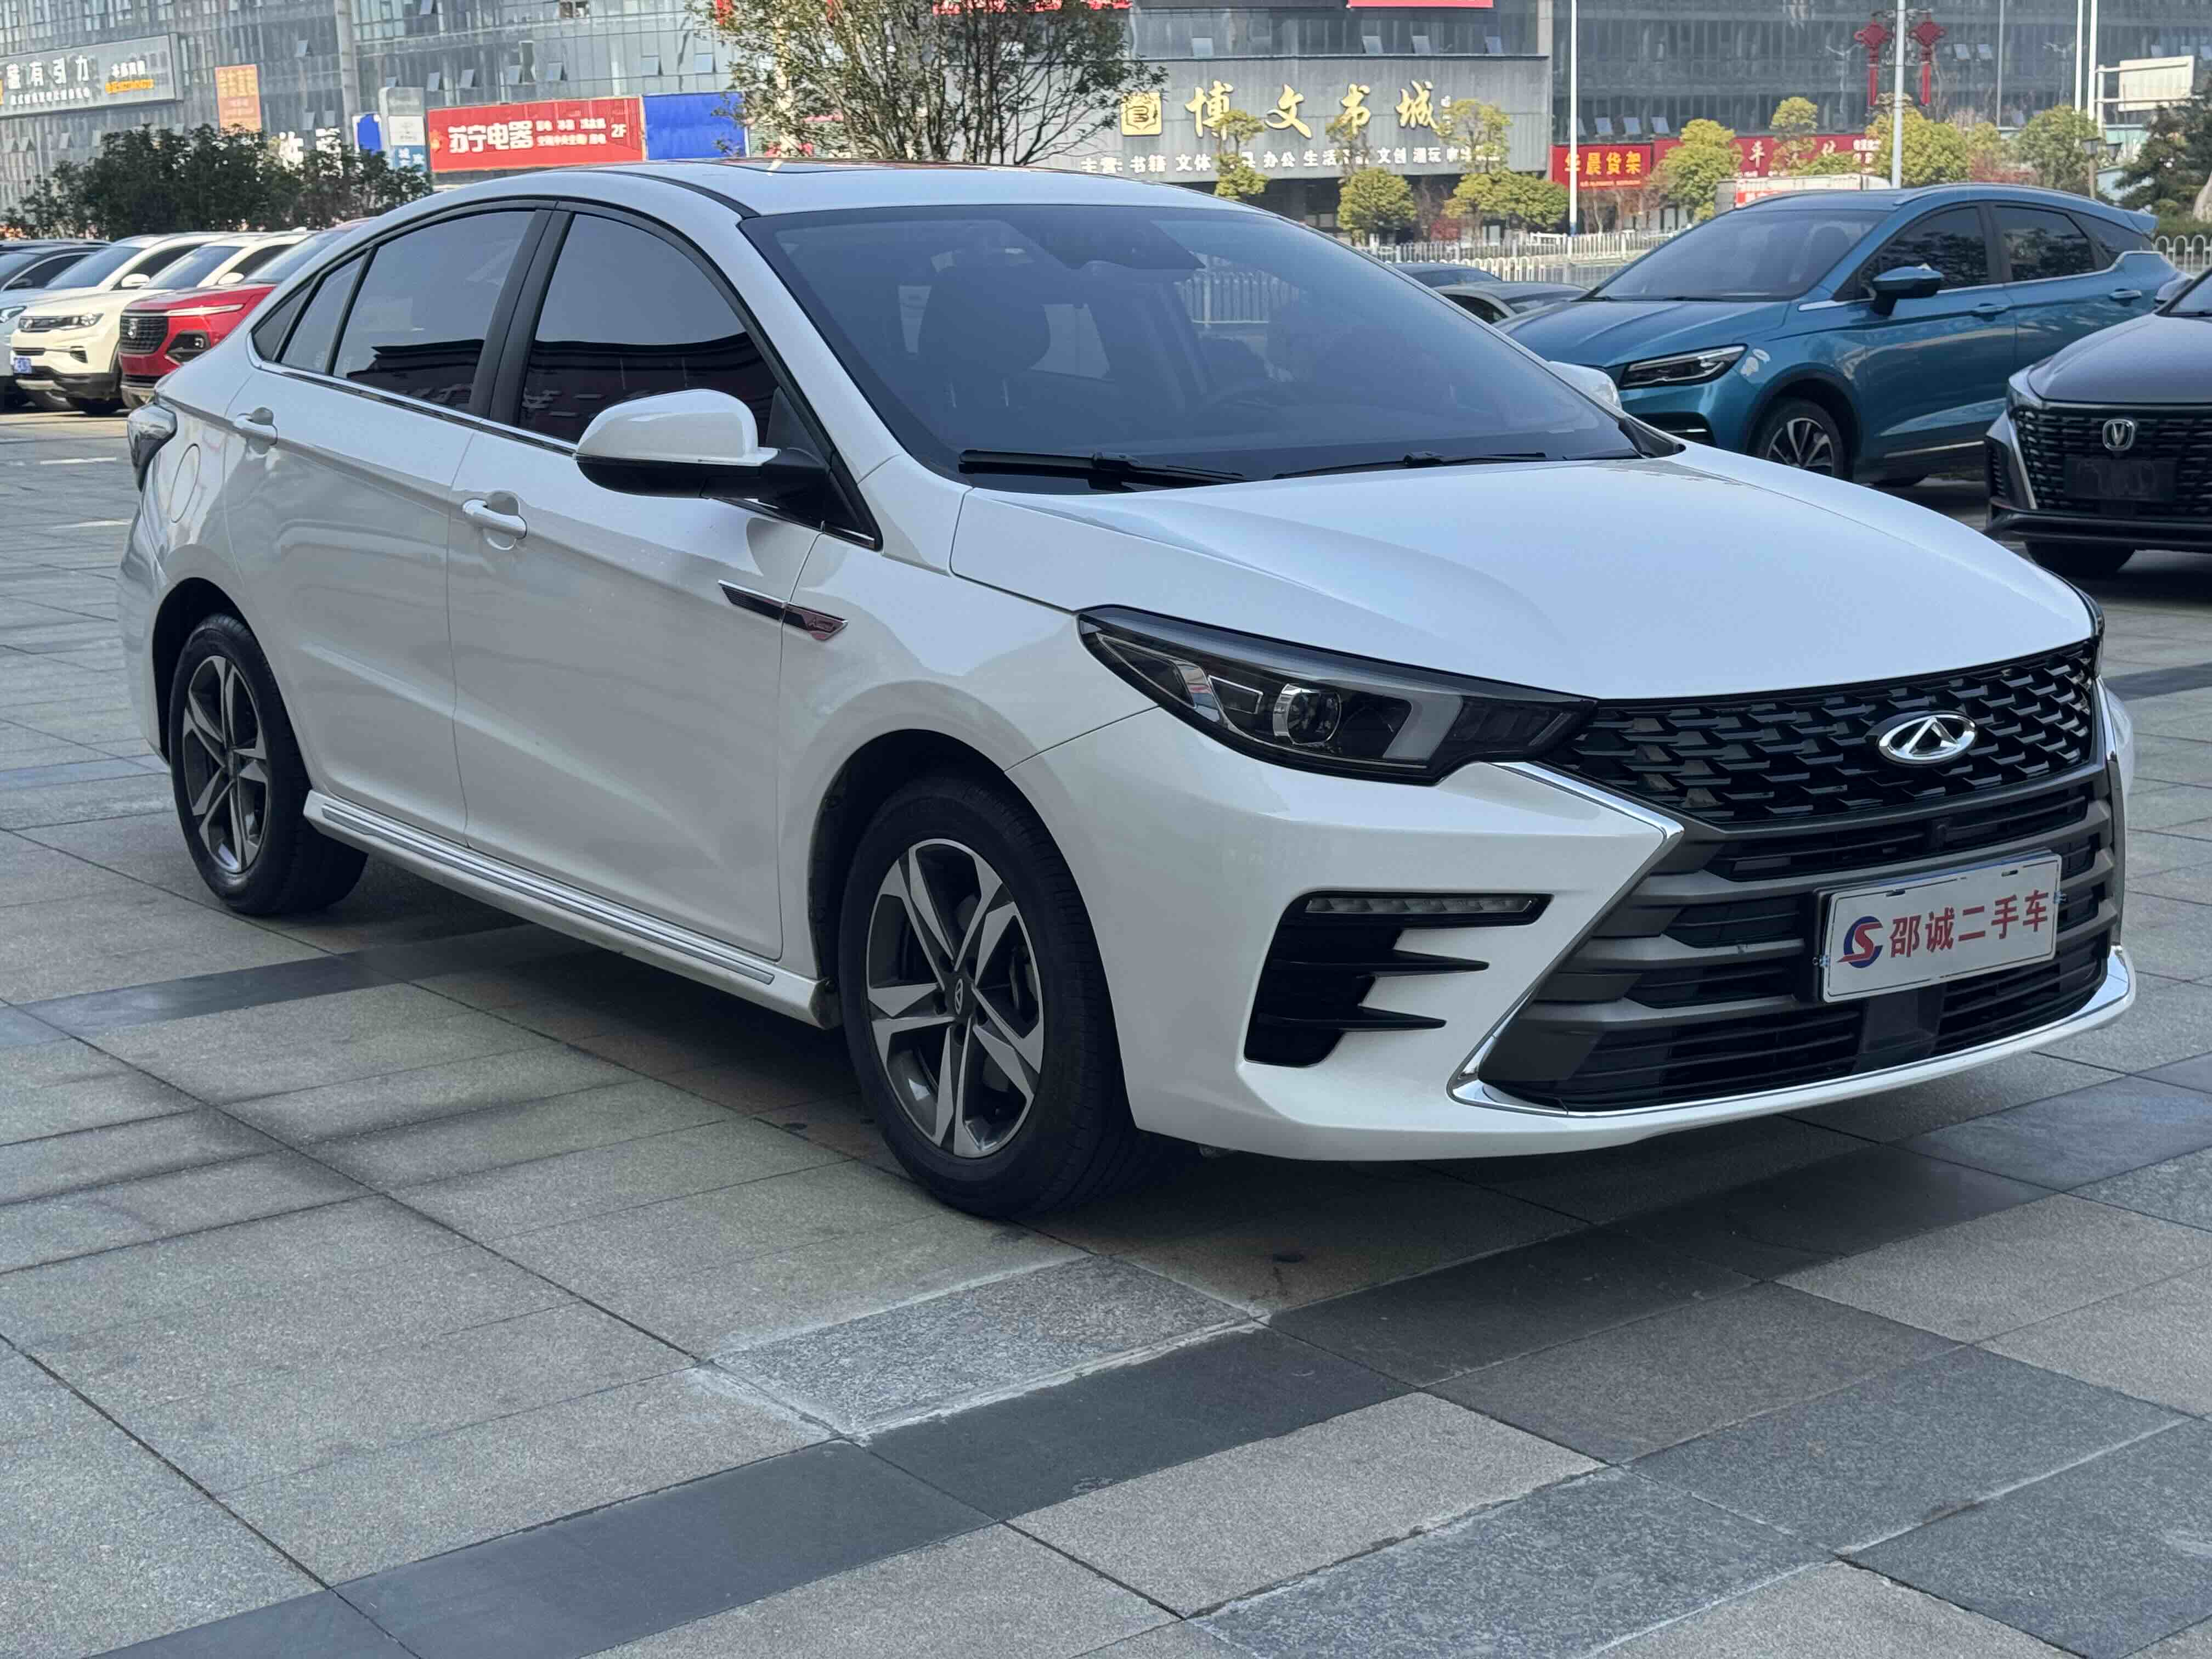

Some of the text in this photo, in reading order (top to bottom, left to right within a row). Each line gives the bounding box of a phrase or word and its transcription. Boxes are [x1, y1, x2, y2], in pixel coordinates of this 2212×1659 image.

[1185, 80, 1440, 141] 博文书城
[448, 121, 533, 154] 苏宁电器
[611, 124, 627, 138] 2F
[1130, 154, 1167, 173] 书籍
[1175, 154, 1211, 172] 文体
[1263, 151, 1295, 168] 办公
[1889, 889, 2049, 958] 邵诚二手车
